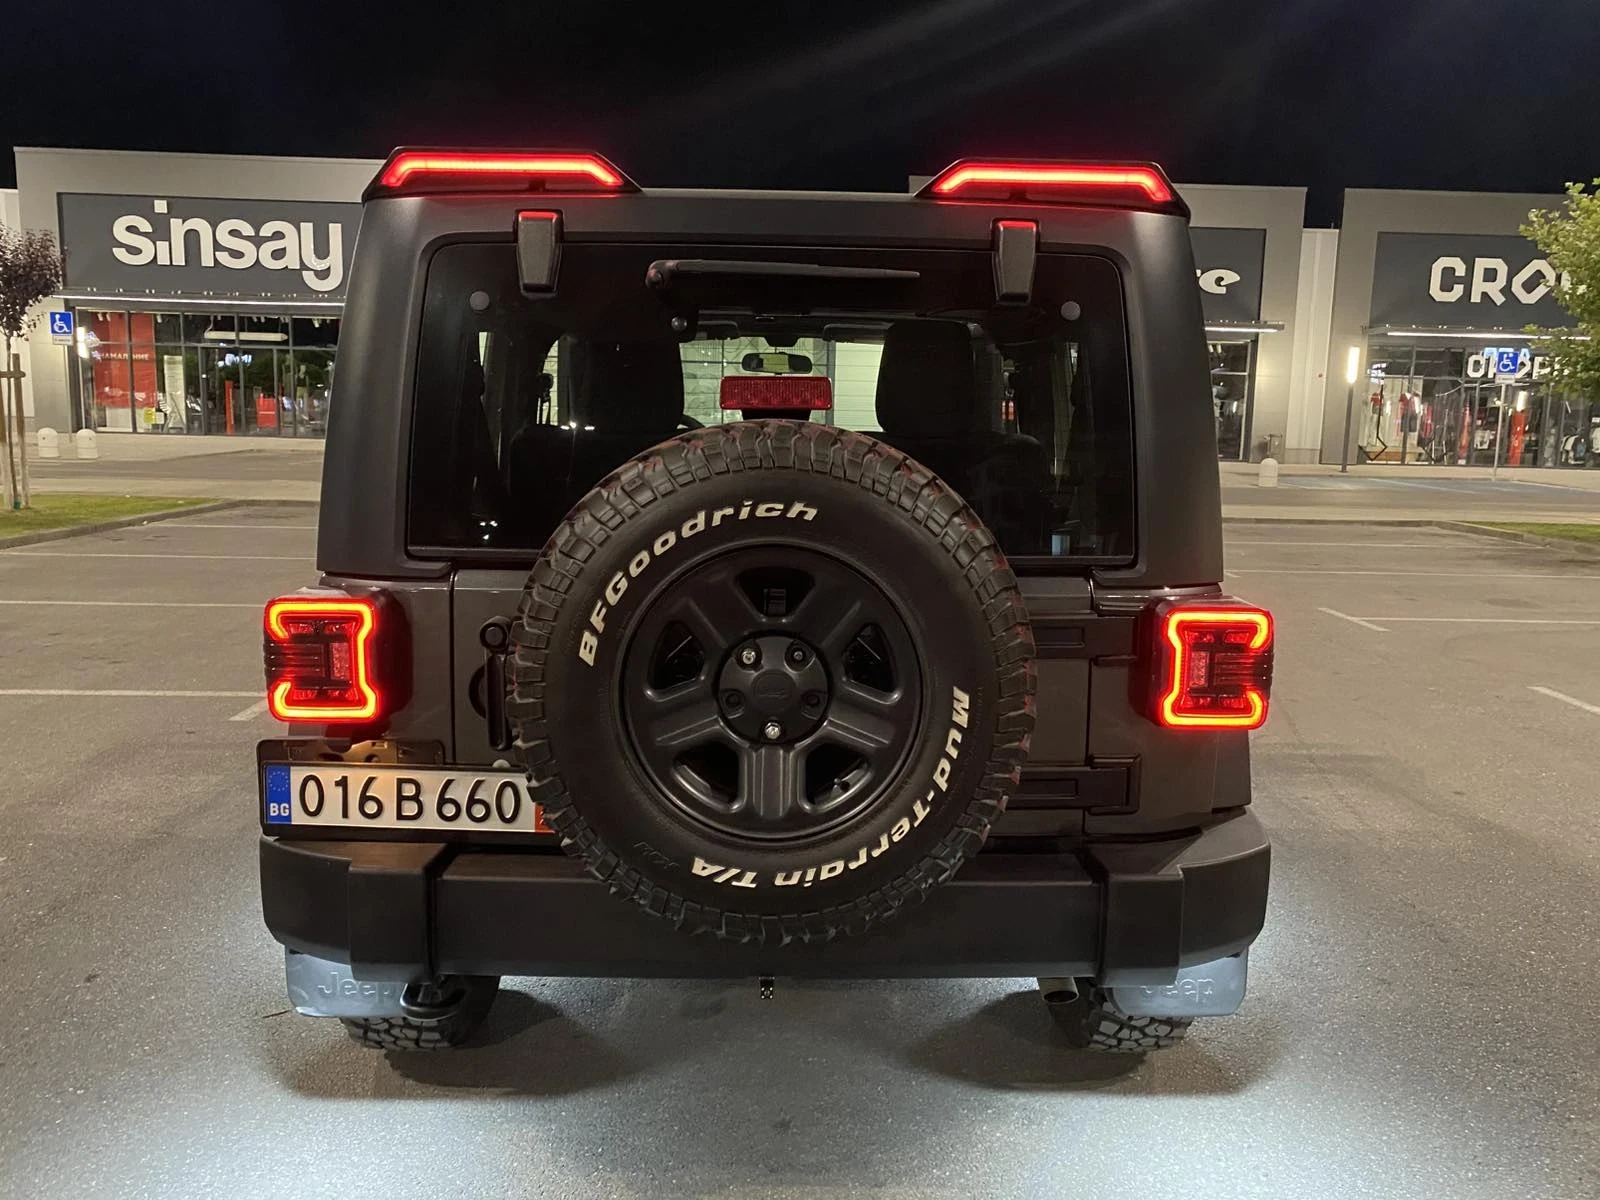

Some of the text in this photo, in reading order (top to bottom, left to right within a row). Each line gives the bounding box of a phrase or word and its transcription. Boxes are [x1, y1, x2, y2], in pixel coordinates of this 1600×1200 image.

[112, 199, 344, 292] sinsay
[579, 500, 818, 667] BFGoodrich
[269, 802, 290, 817] BG
[775, 686, 970, 889] Mud-Terrain
[691, 857, 757, 889] T/A
